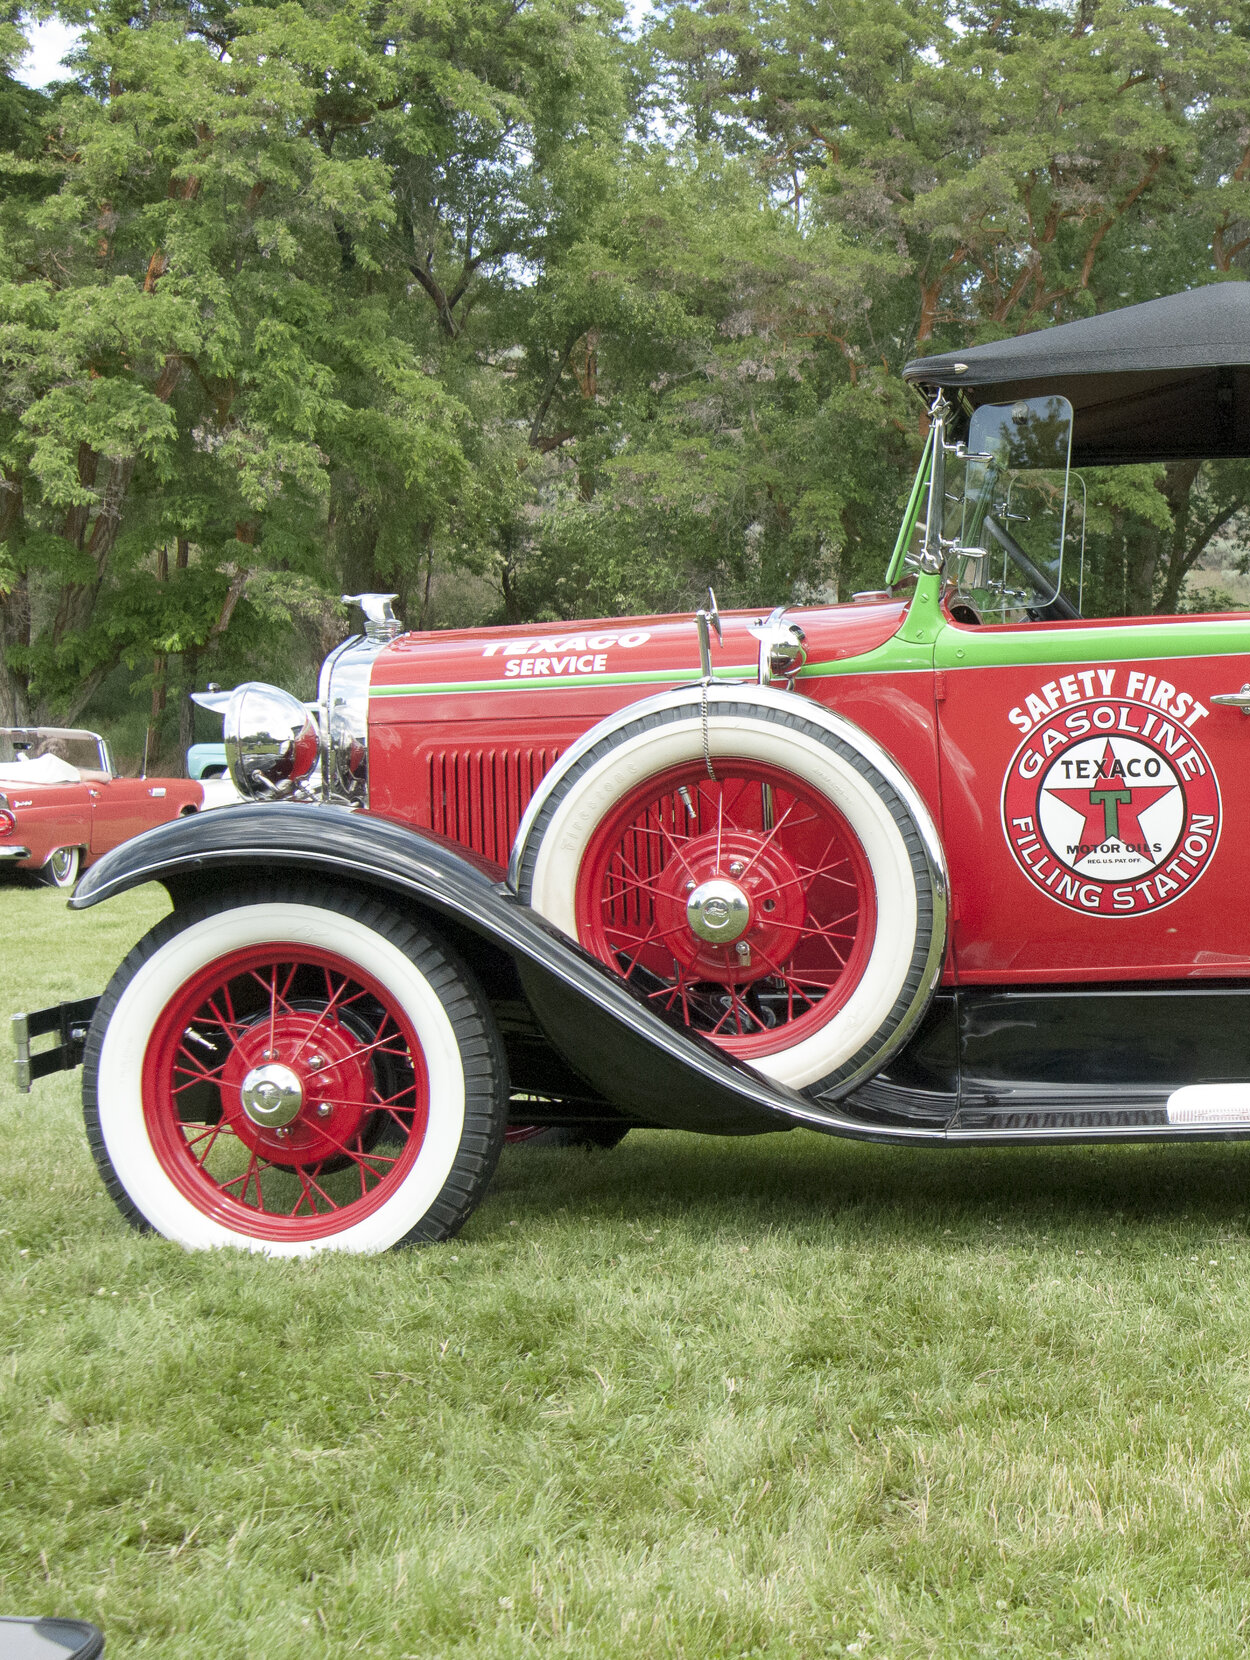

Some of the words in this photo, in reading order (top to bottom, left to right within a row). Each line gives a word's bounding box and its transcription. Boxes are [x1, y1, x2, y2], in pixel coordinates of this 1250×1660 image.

[482, 632, 652, 657] TEXACO
[504, 653, 608, 677] SERVICE
[1008, 668, 1116, 734] SAFETY
[1126, 670, 1210, 728] FIRST
[1017, 705, 1208, 782] GASOLINE
[1061, 757, 1161, 780] TEXACO
[1089, 789, 1132, 839] T
[1011, 814, 1104, 908] FILLING
[1112, 813, 1216, 910] STATION
[1066, 844, 1120, 855] MOTOR
[1125, 842, 1162, 853] OILS
